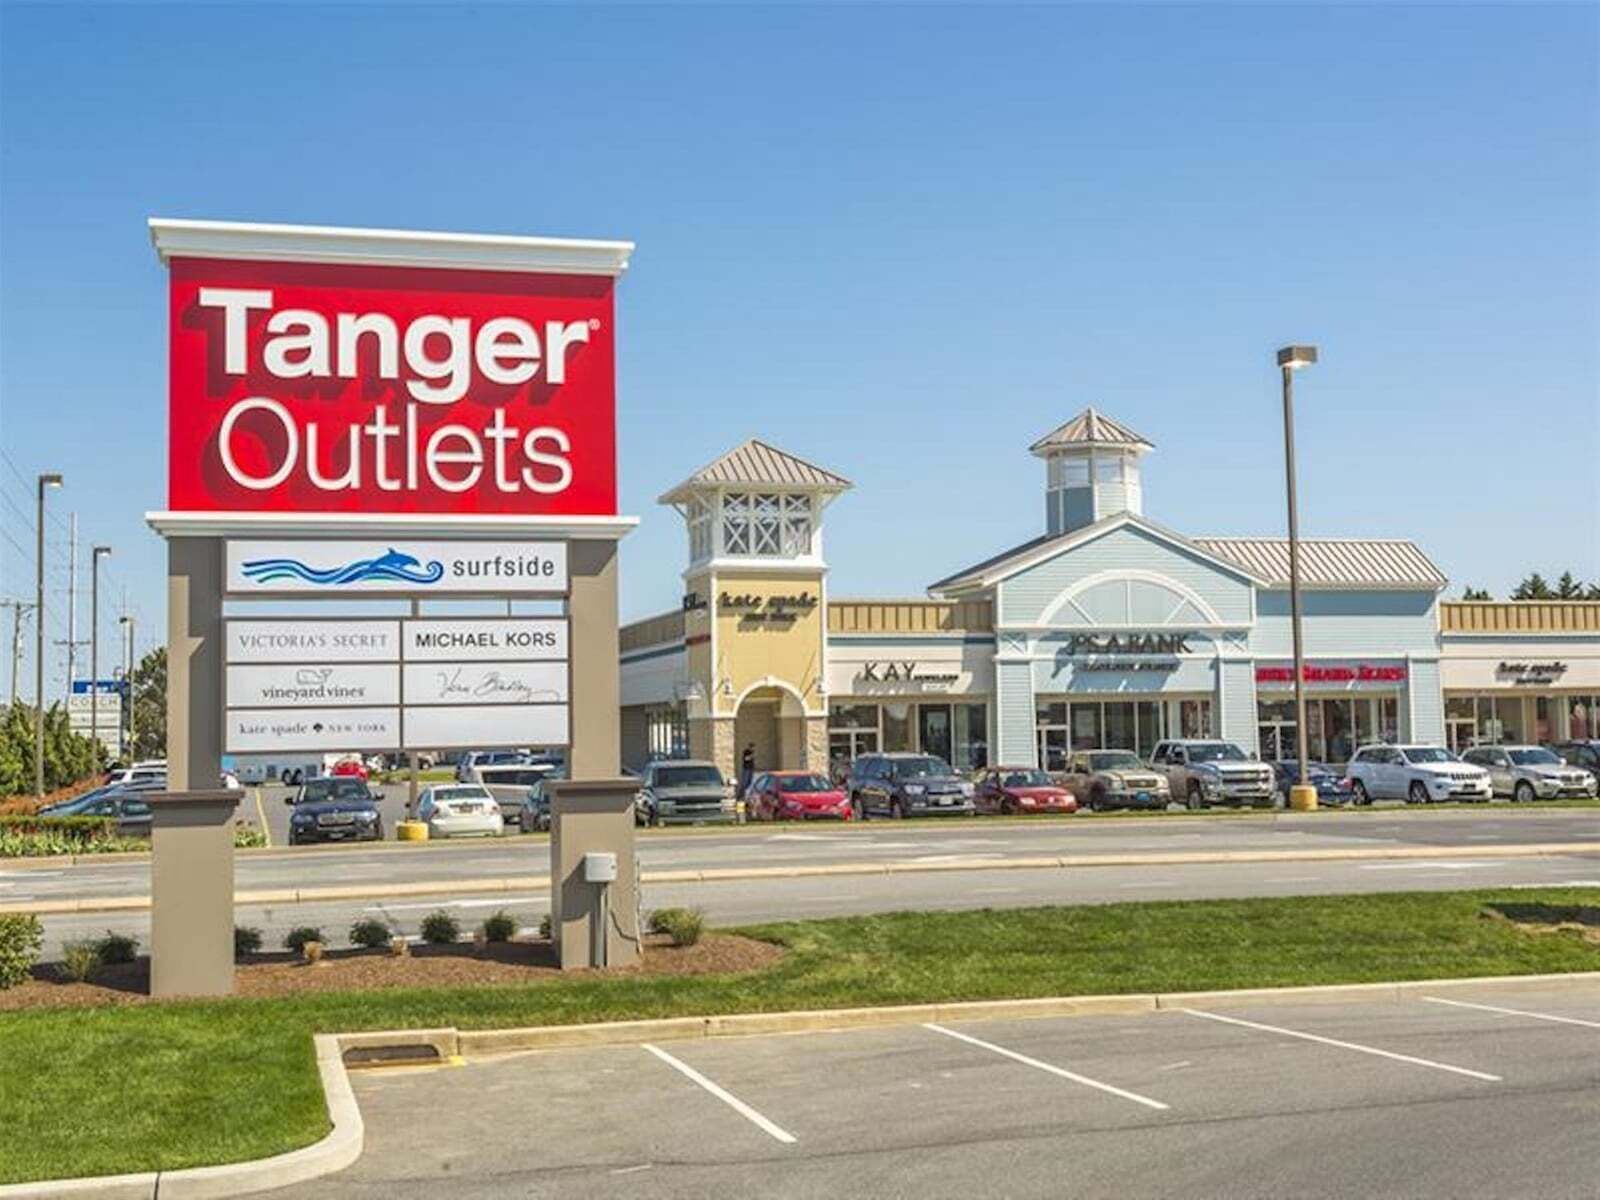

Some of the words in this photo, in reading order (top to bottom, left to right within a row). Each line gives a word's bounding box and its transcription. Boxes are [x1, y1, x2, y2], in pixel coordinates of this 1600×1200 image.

[218, 397, 573, 493] Outlets
[452, 556, 555, 577] surfside
[239, 634, 326, 648] VICTORIA'S
[333, 634, 388, 648] SECRET
[415, 633, 499, 648] MICHAEL
[506, 631, 557, 647] KORS
[864, 661, 916, 681] KAY
[261, 685, 326, 701] vineyard
[327, 685, 365, 698] vines
[239, 723, 266, 735] kate
[271, 723, 308, 737] spade
